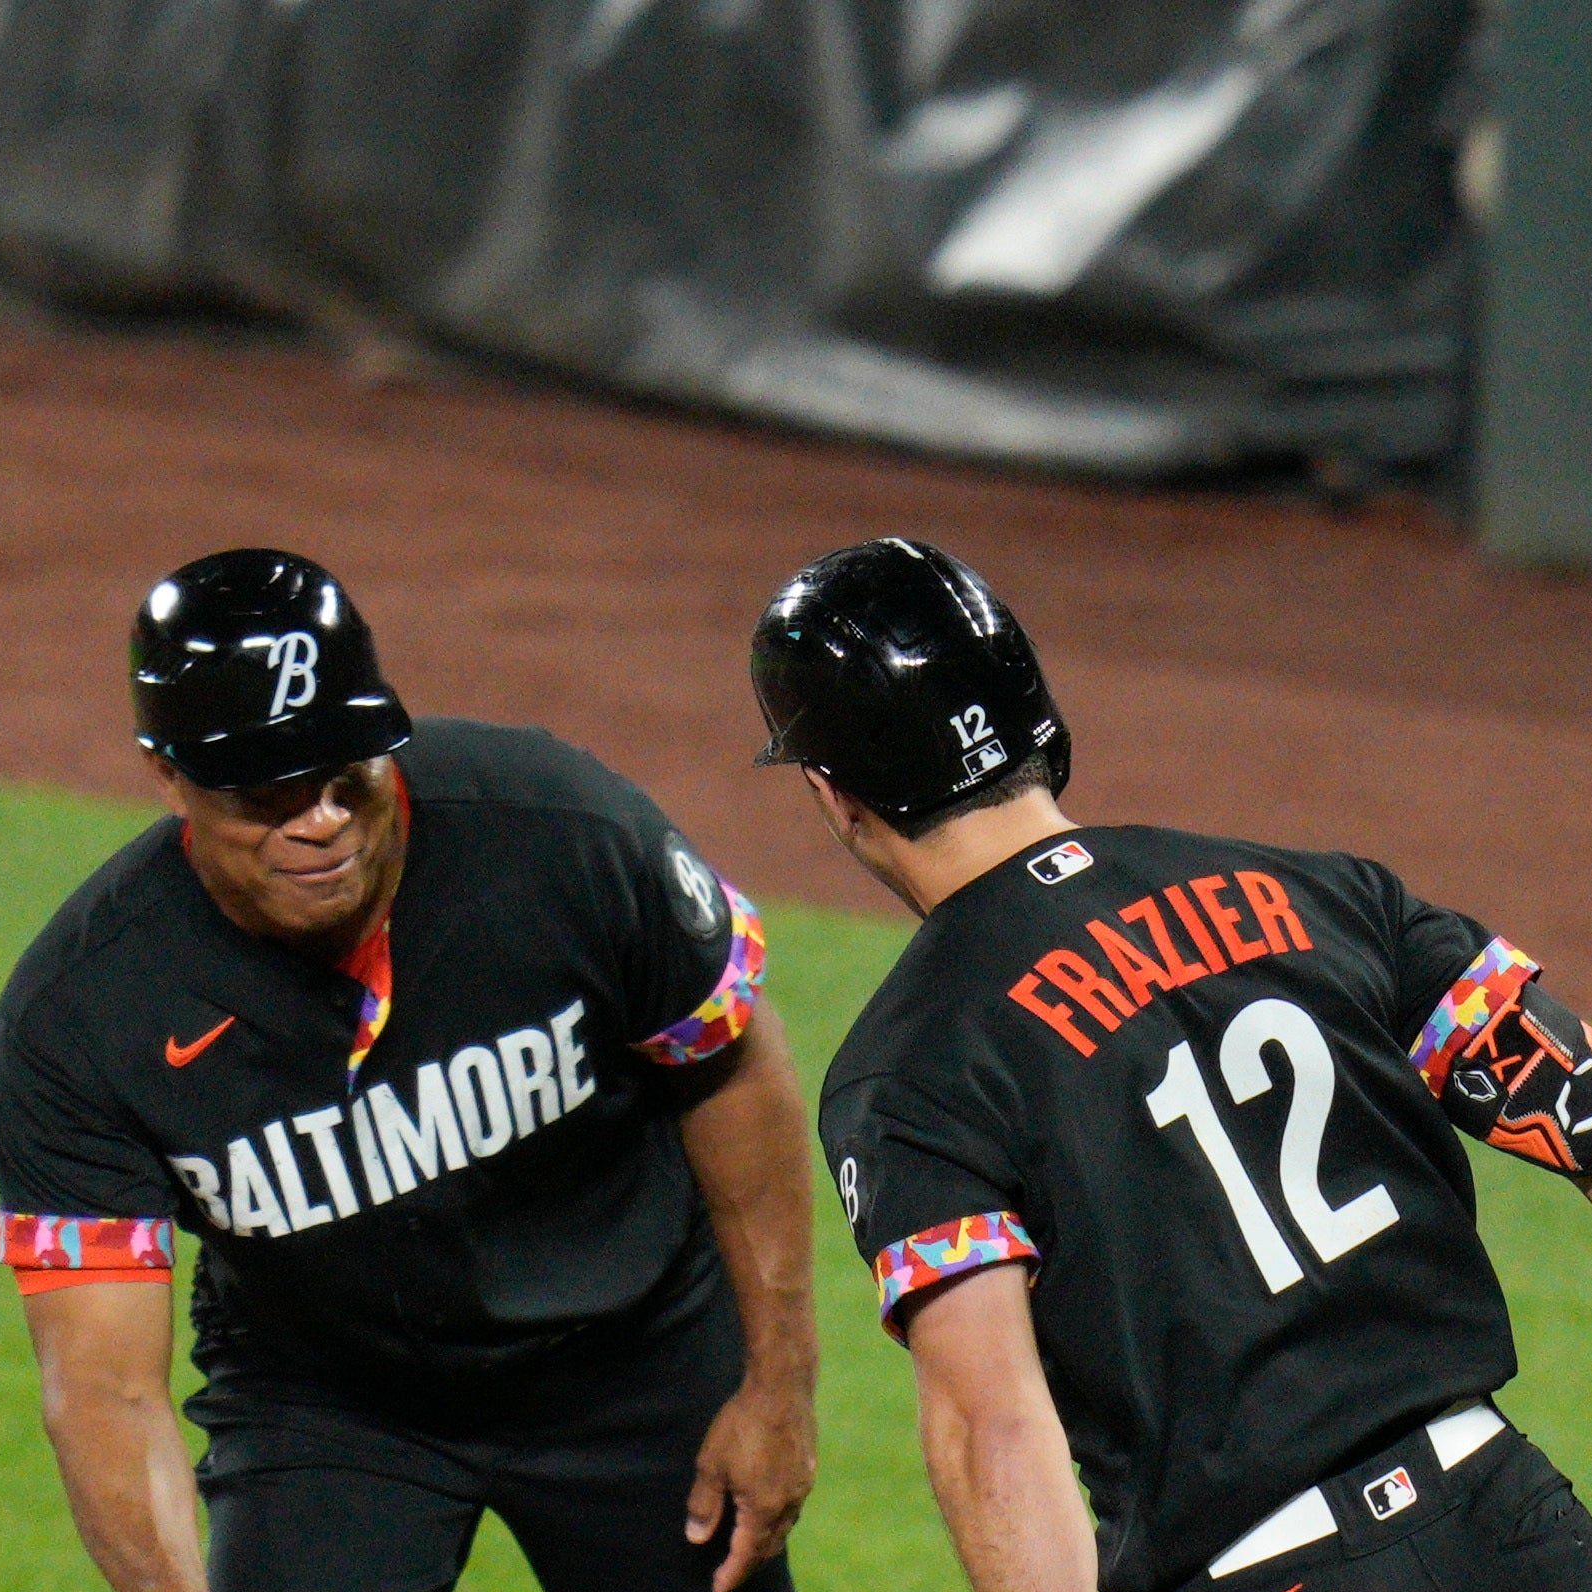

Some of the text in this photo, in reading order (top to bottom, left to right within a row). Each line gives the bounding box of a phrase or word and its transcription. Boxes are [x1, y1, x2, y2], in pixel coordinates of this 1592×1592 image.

[266, 631, 318, 717] B
[949, 704, 995, 750] 12
[1007, 870, 1313, 1058] FRAZIER
[170, 998, 597, 1238] BALTIMORE
[1145, 998, 1400, 1294] 12
